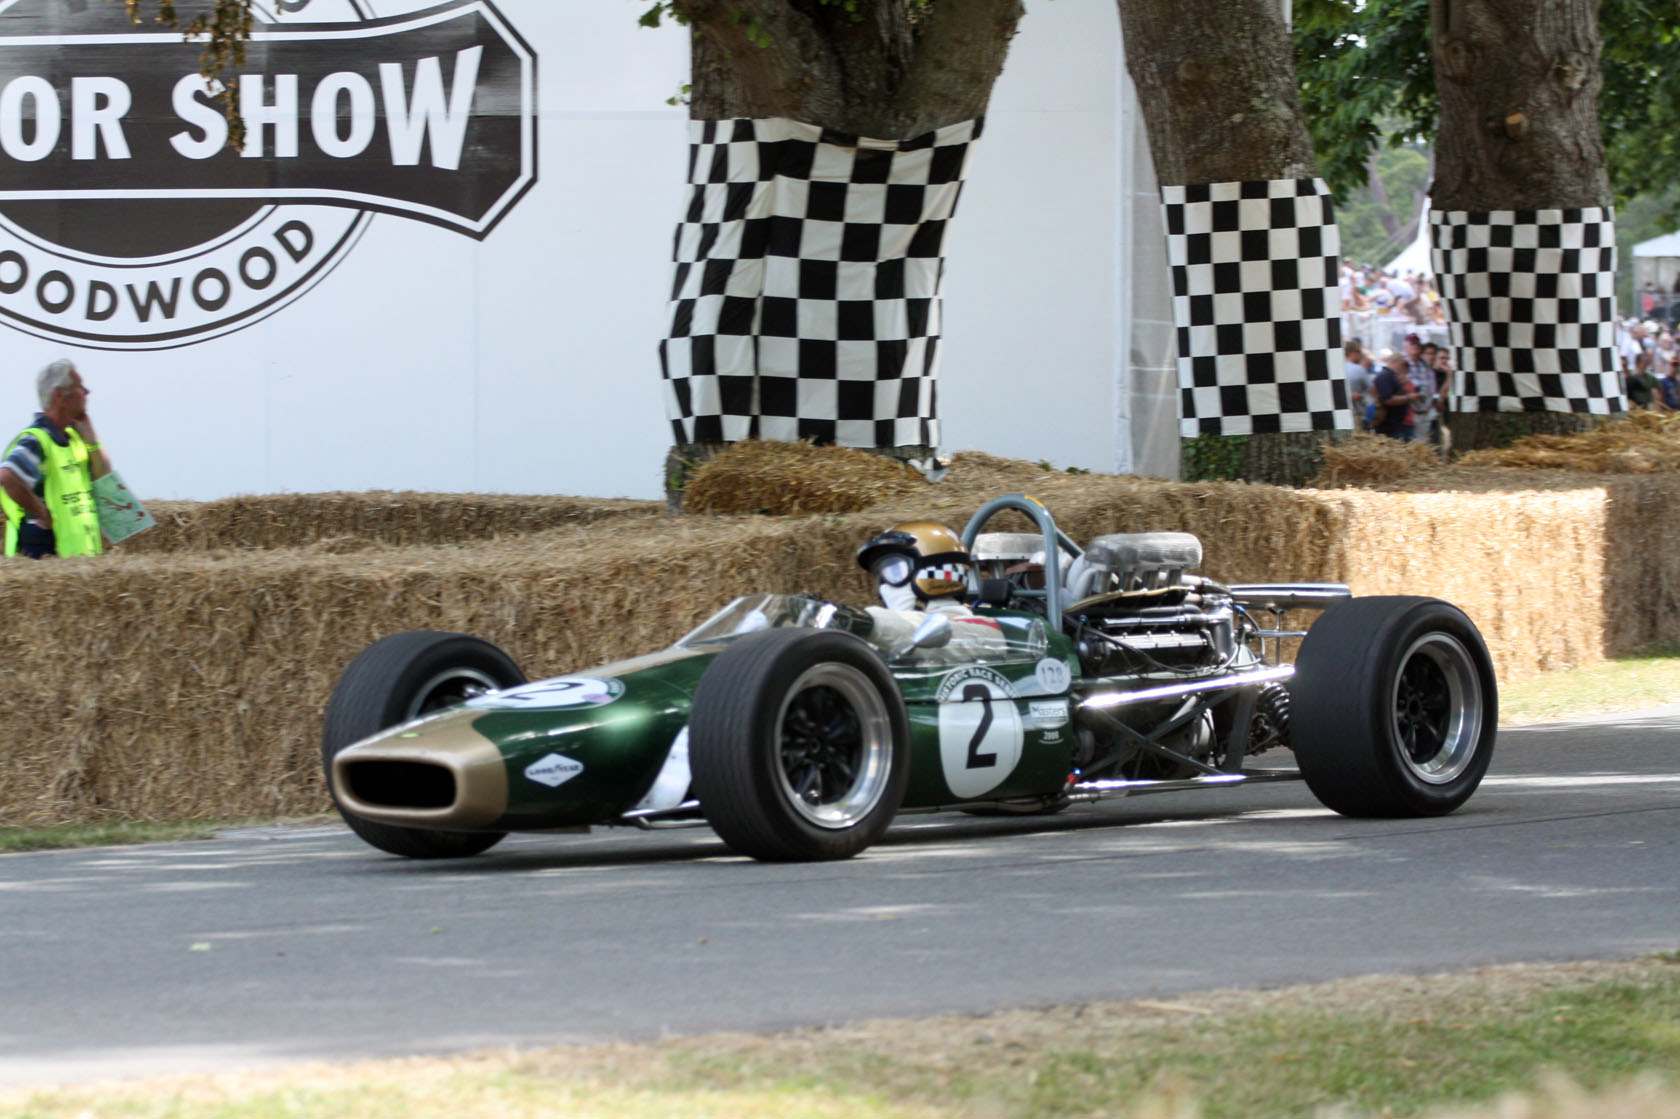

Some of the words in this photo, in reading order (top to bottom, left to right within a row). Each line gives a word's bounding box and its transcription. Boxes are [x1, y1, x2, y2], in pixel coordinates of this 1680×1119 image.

[169, 45, 484, 170] SHOW
[968, 667, 993, 681] RACE
[963, 684, 998, 769] 2
